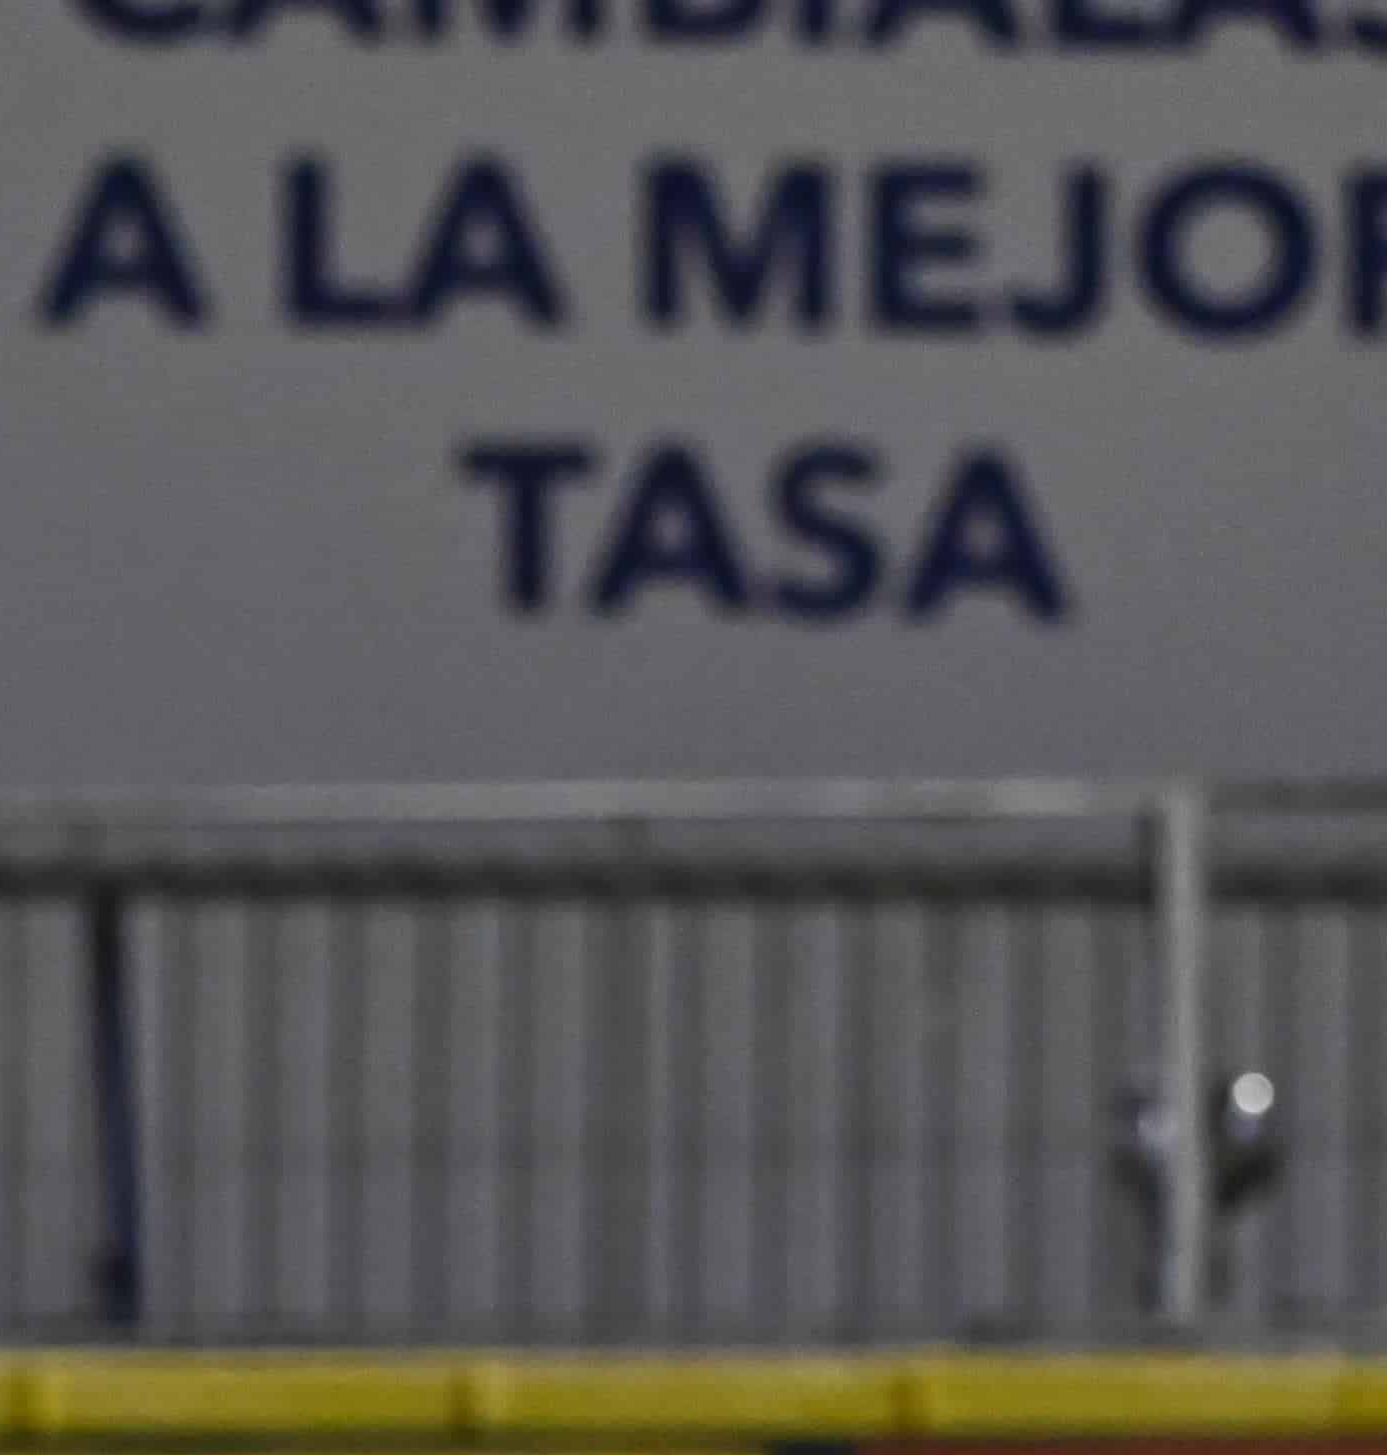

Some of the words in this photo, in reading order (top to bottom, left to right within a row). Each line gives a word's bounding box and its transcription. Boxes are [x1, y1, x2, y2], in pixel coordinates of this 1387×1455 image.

[35, 150, 209, 334] A
[282, 148, 567, 334] LA
[457, 440, 1072, 622] TASA
